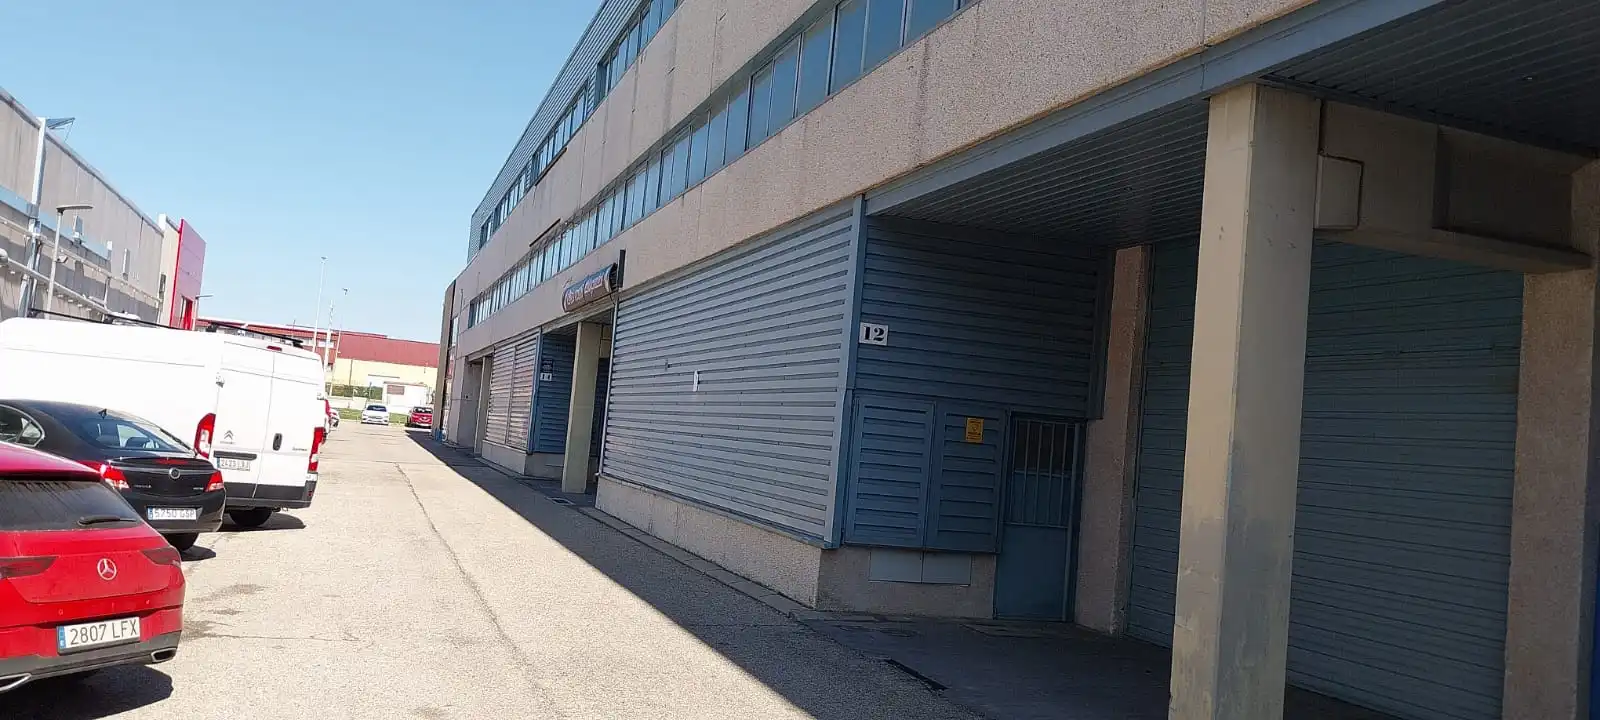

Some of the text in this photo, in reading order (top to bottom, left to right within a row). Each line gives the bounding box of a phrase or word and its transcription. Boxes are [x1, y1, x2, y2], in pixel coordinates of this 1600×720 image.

[863, 326, 885, 342] 12
[70, 619, 138, 645] 2807 LFX
